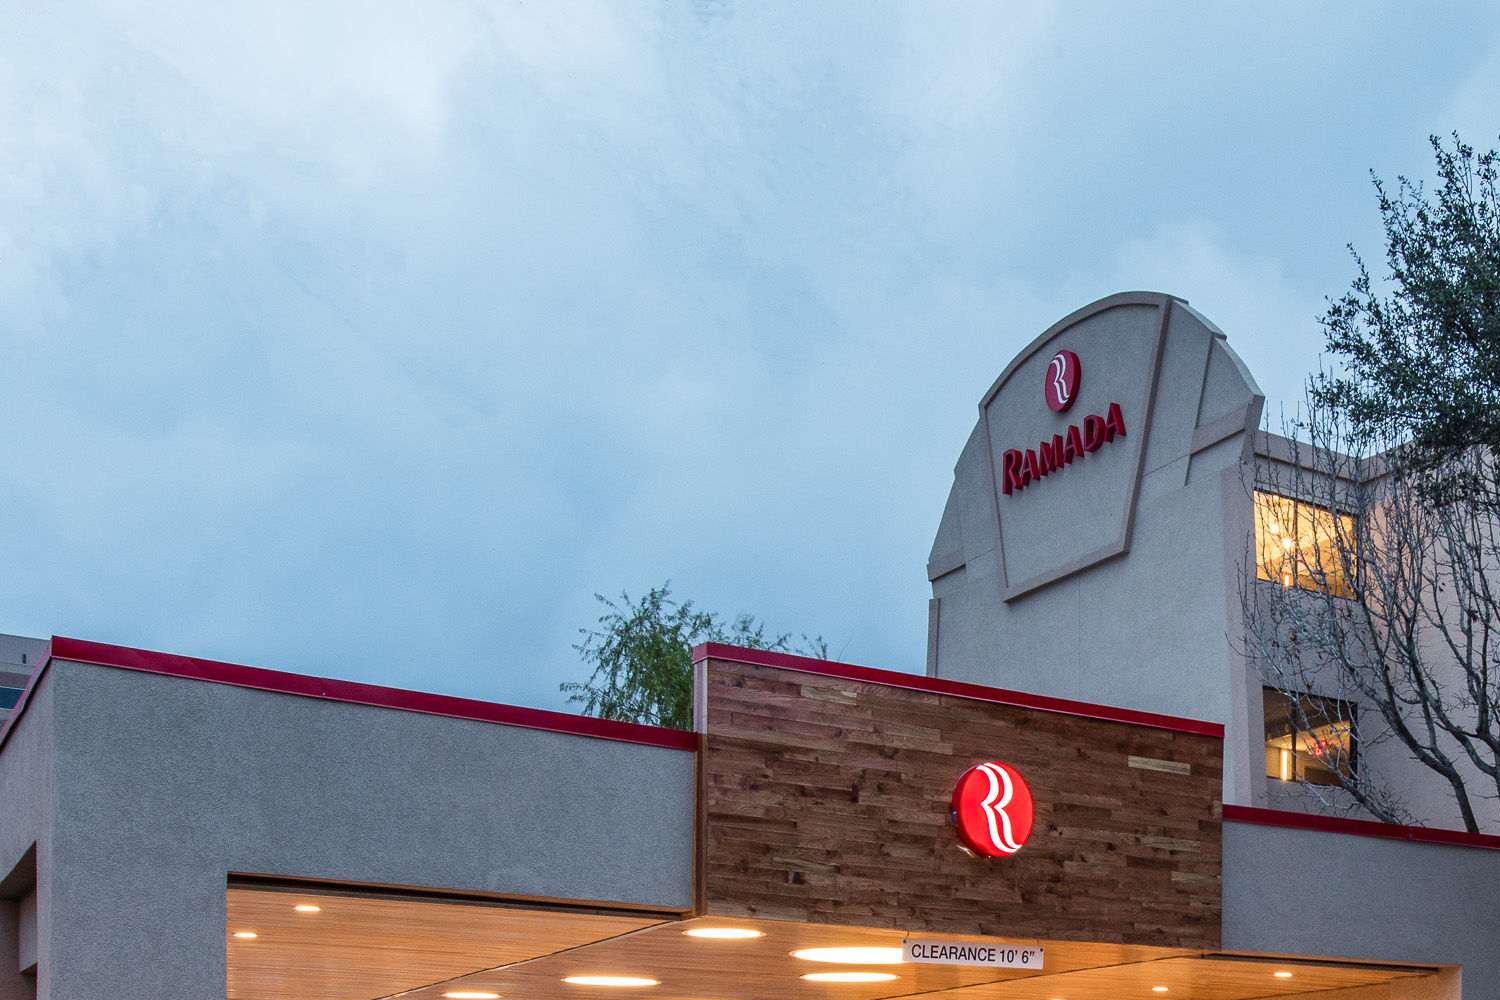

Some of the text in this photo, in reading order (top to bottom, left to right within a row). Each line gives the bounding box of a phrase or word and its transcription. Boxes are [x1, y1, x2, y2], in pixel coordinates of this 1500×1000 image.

[1002, 402, 1127, 496] RAMADA
[911, 943, 996, 962] CLEARANCE
[999, 949, 1018, 964] 10'
